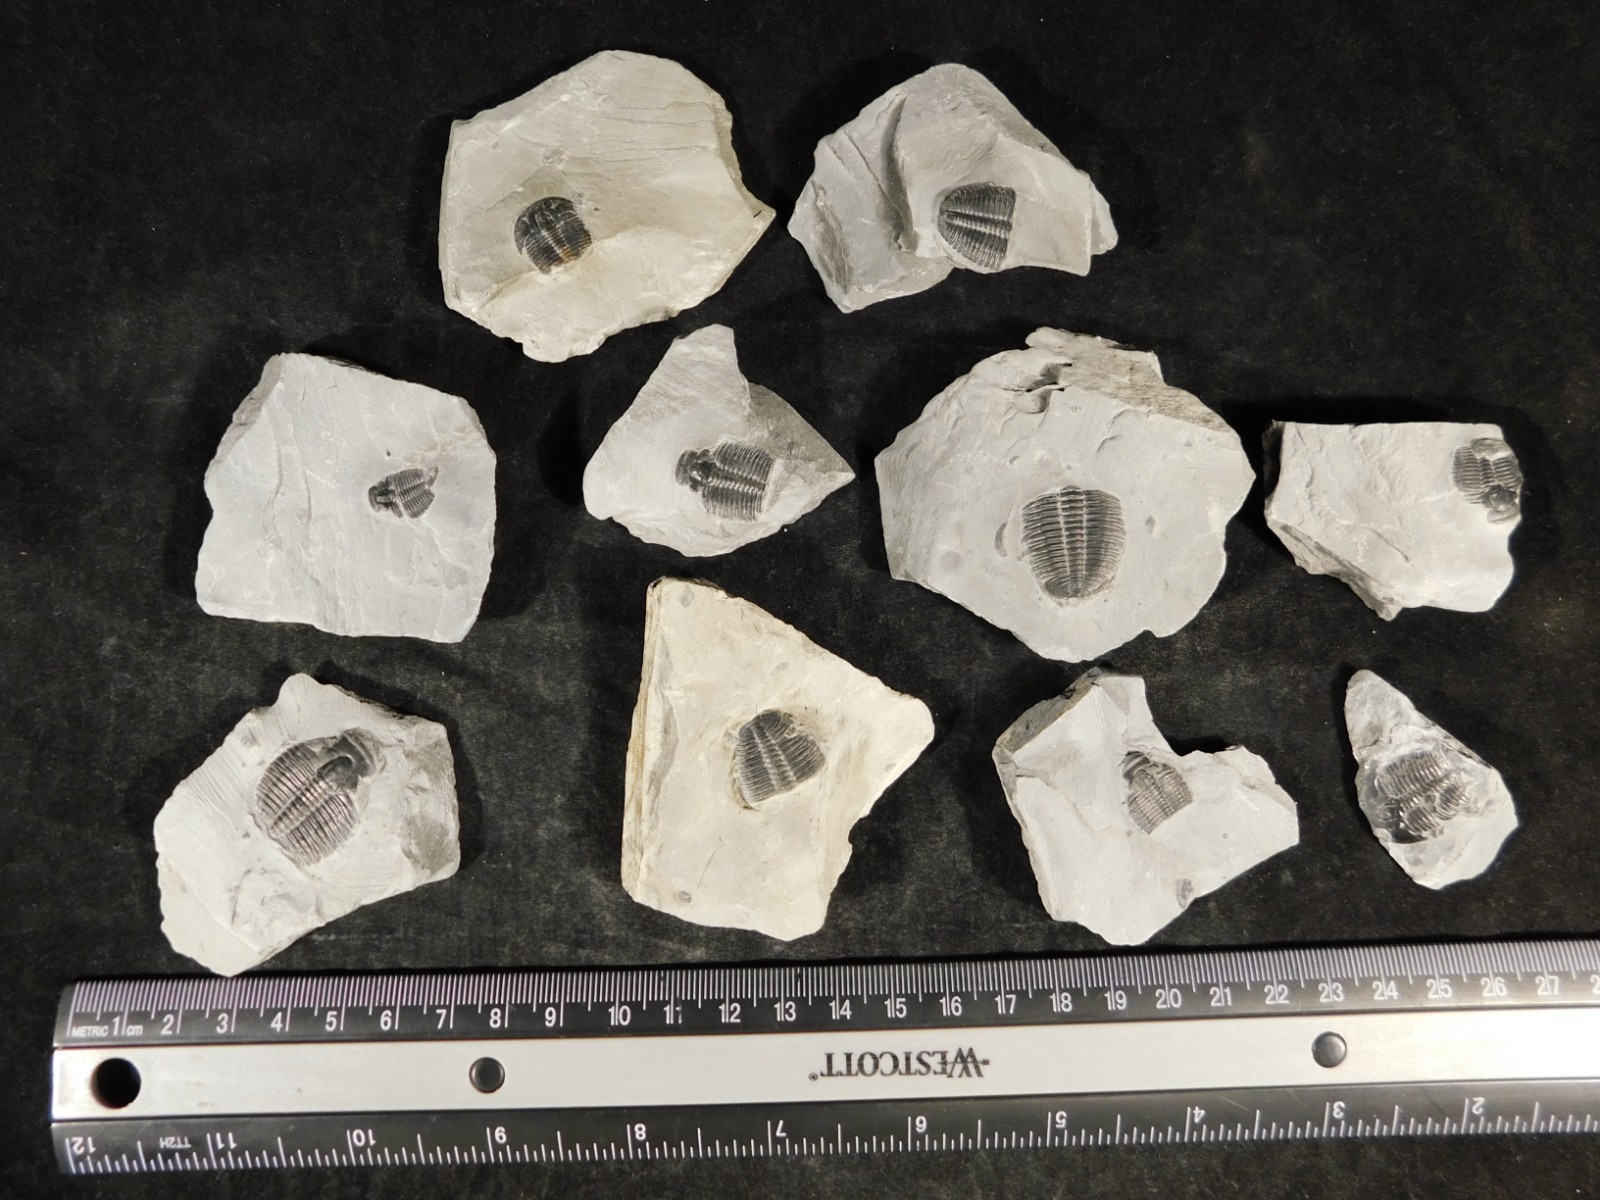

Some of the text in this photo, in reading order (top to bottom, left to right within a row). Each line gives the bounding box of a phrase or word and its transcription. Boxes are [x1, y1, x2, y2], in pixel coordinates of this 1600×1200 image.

[71, 1025, 108, 1037] METRIC
[112, 1016, 120, 1036] 1
[126, 1024, 143, 1035] cm
[161, 1015, 174, 1034] 2
[216, 1013, 228, 1033] 3
[270, 1012, 282, 1032] 4
[325, 1011, 337, 1031] 5
[380, 1010, 392, 1030] 6
[436, 1009, 447, 1029] 7
[489, 1008, 501, 1028] 8
[544, 1007, 557, 1027] 9
[608, 1005, 631, 1026] 10
[663, 1004, 682, 1024] 11
[719, 1003, 741, 1023] 12
[774, 1001, 796, 1022] 13
[829, 1000, 852, 1020] 14
[884, 998, 907, 1018] 15
[939, 996, 962, 1017] 16
[995, 995, 1016, 1014] 17
[1049, 992, 1072, 1013] 18
[1104, 990, 1127, 1011] 19
[1155, 988, 1182, 1009] 20
[1209, 986, 1232, 1007] 21
[1264, 984, 1290, 1005] 22
[1318, 982, 1345, 1003] 23
[1372, 980, 1399, 1000] 24
[1426, 978, 1452, 998] 25
[1480, 977, 1508, 997] 26
[1535, 975, 1559, 995] 27
[1332, 1101, 1346, 1118] 3
[1471, 1097, 1485, 1114] 2
[1055, 1111, 1067, 1128] 5
[1193, 1106, 1206, 1123] 4
[634, 1123, 646, 1141] 8
[775, 1120, 787, 1137] 7
[915, 1116, 927, 1133] 6
[216, 1132, 237, 1149] 11
[352, 1129, 376, 1147] 10
[494, 1126, 507, 1144] 9
[71, 1136, 96, 1155] 12
